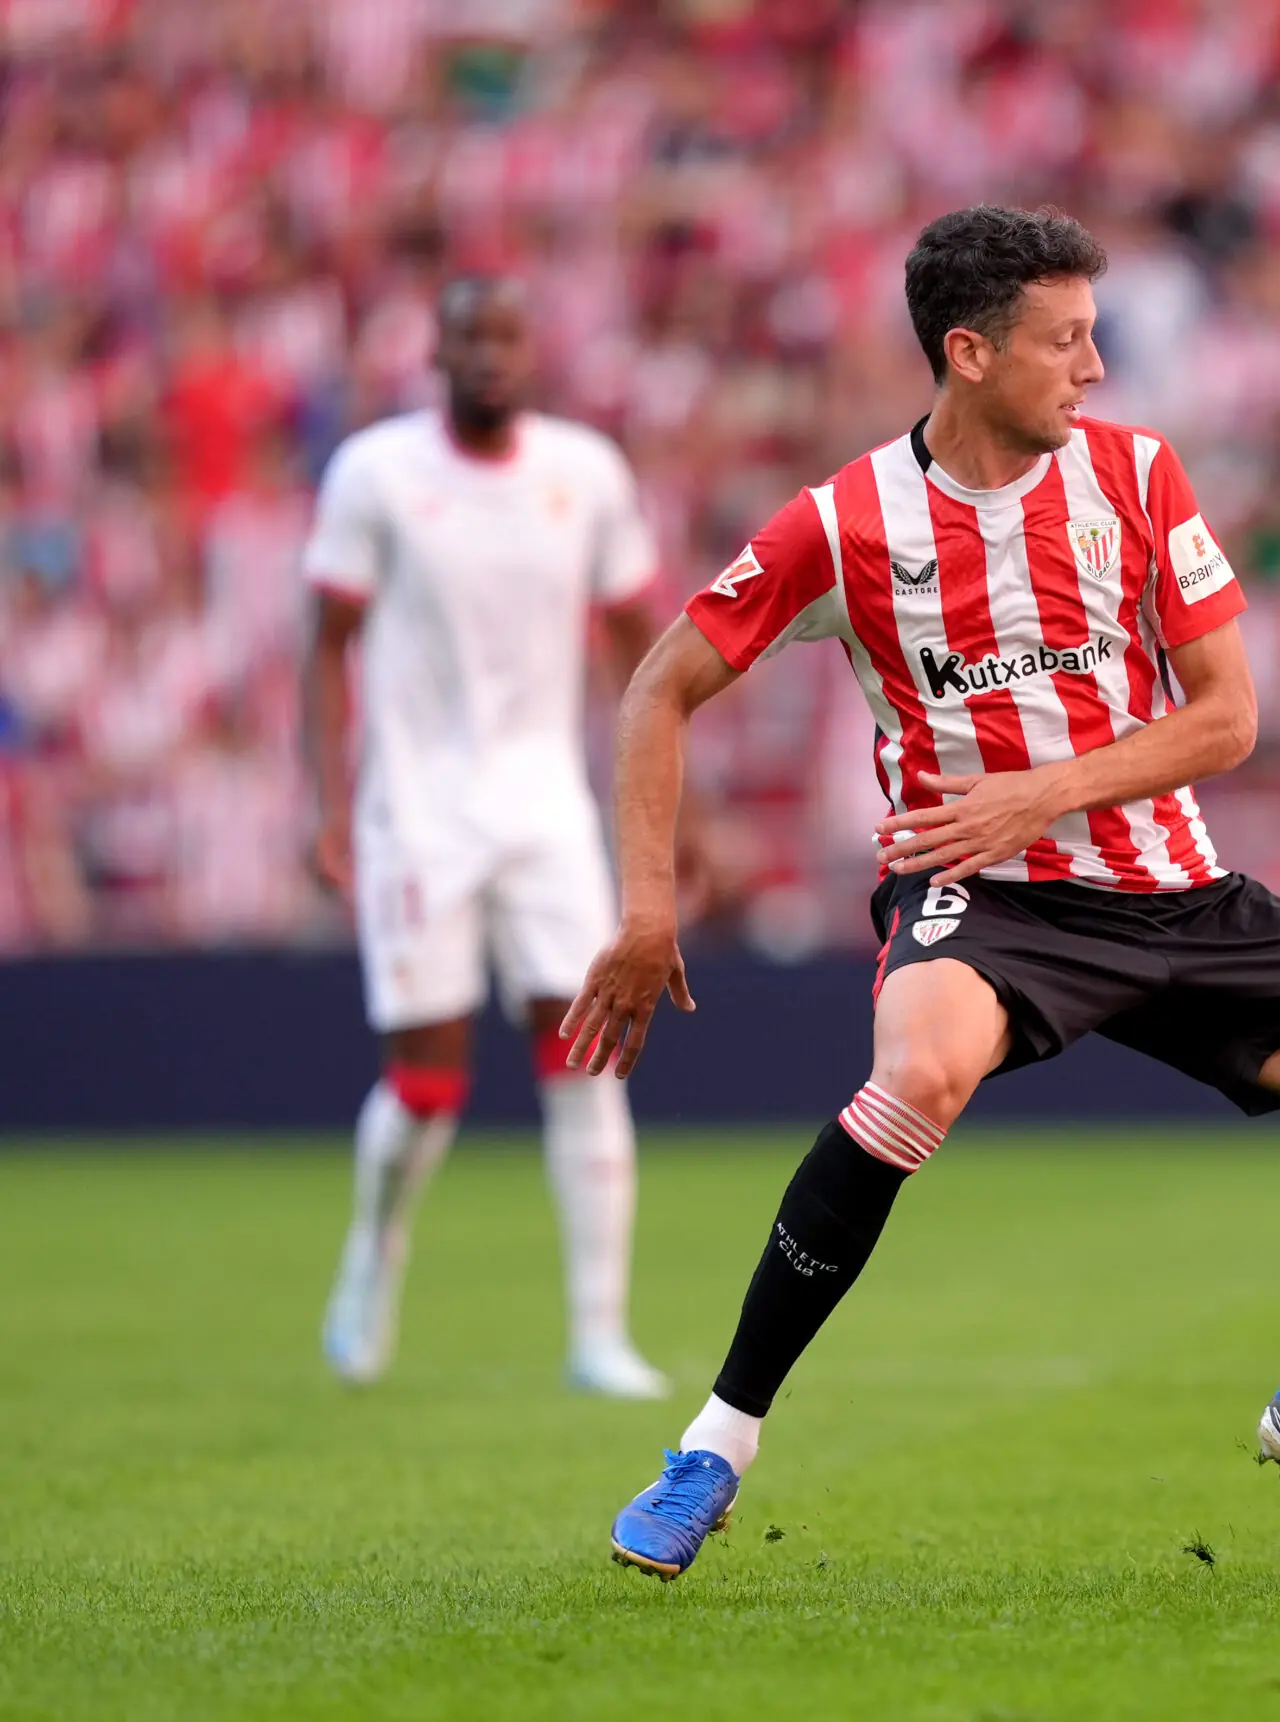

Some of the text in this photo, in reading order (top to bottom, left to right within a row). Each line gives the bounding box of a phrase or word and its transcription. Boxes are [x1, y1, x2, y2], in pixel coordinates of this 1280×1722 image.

[1086, 561, 1110, 578] BILBAO
[895, 586, 938, 596] CASTORE
[919, 636, 1112, 699] Kutxabank
[922, 882, 971, 917] 6
[777, 1222, 839, 1273] ATHLETIC
[779, 1240, 814, 1276] CLUB
